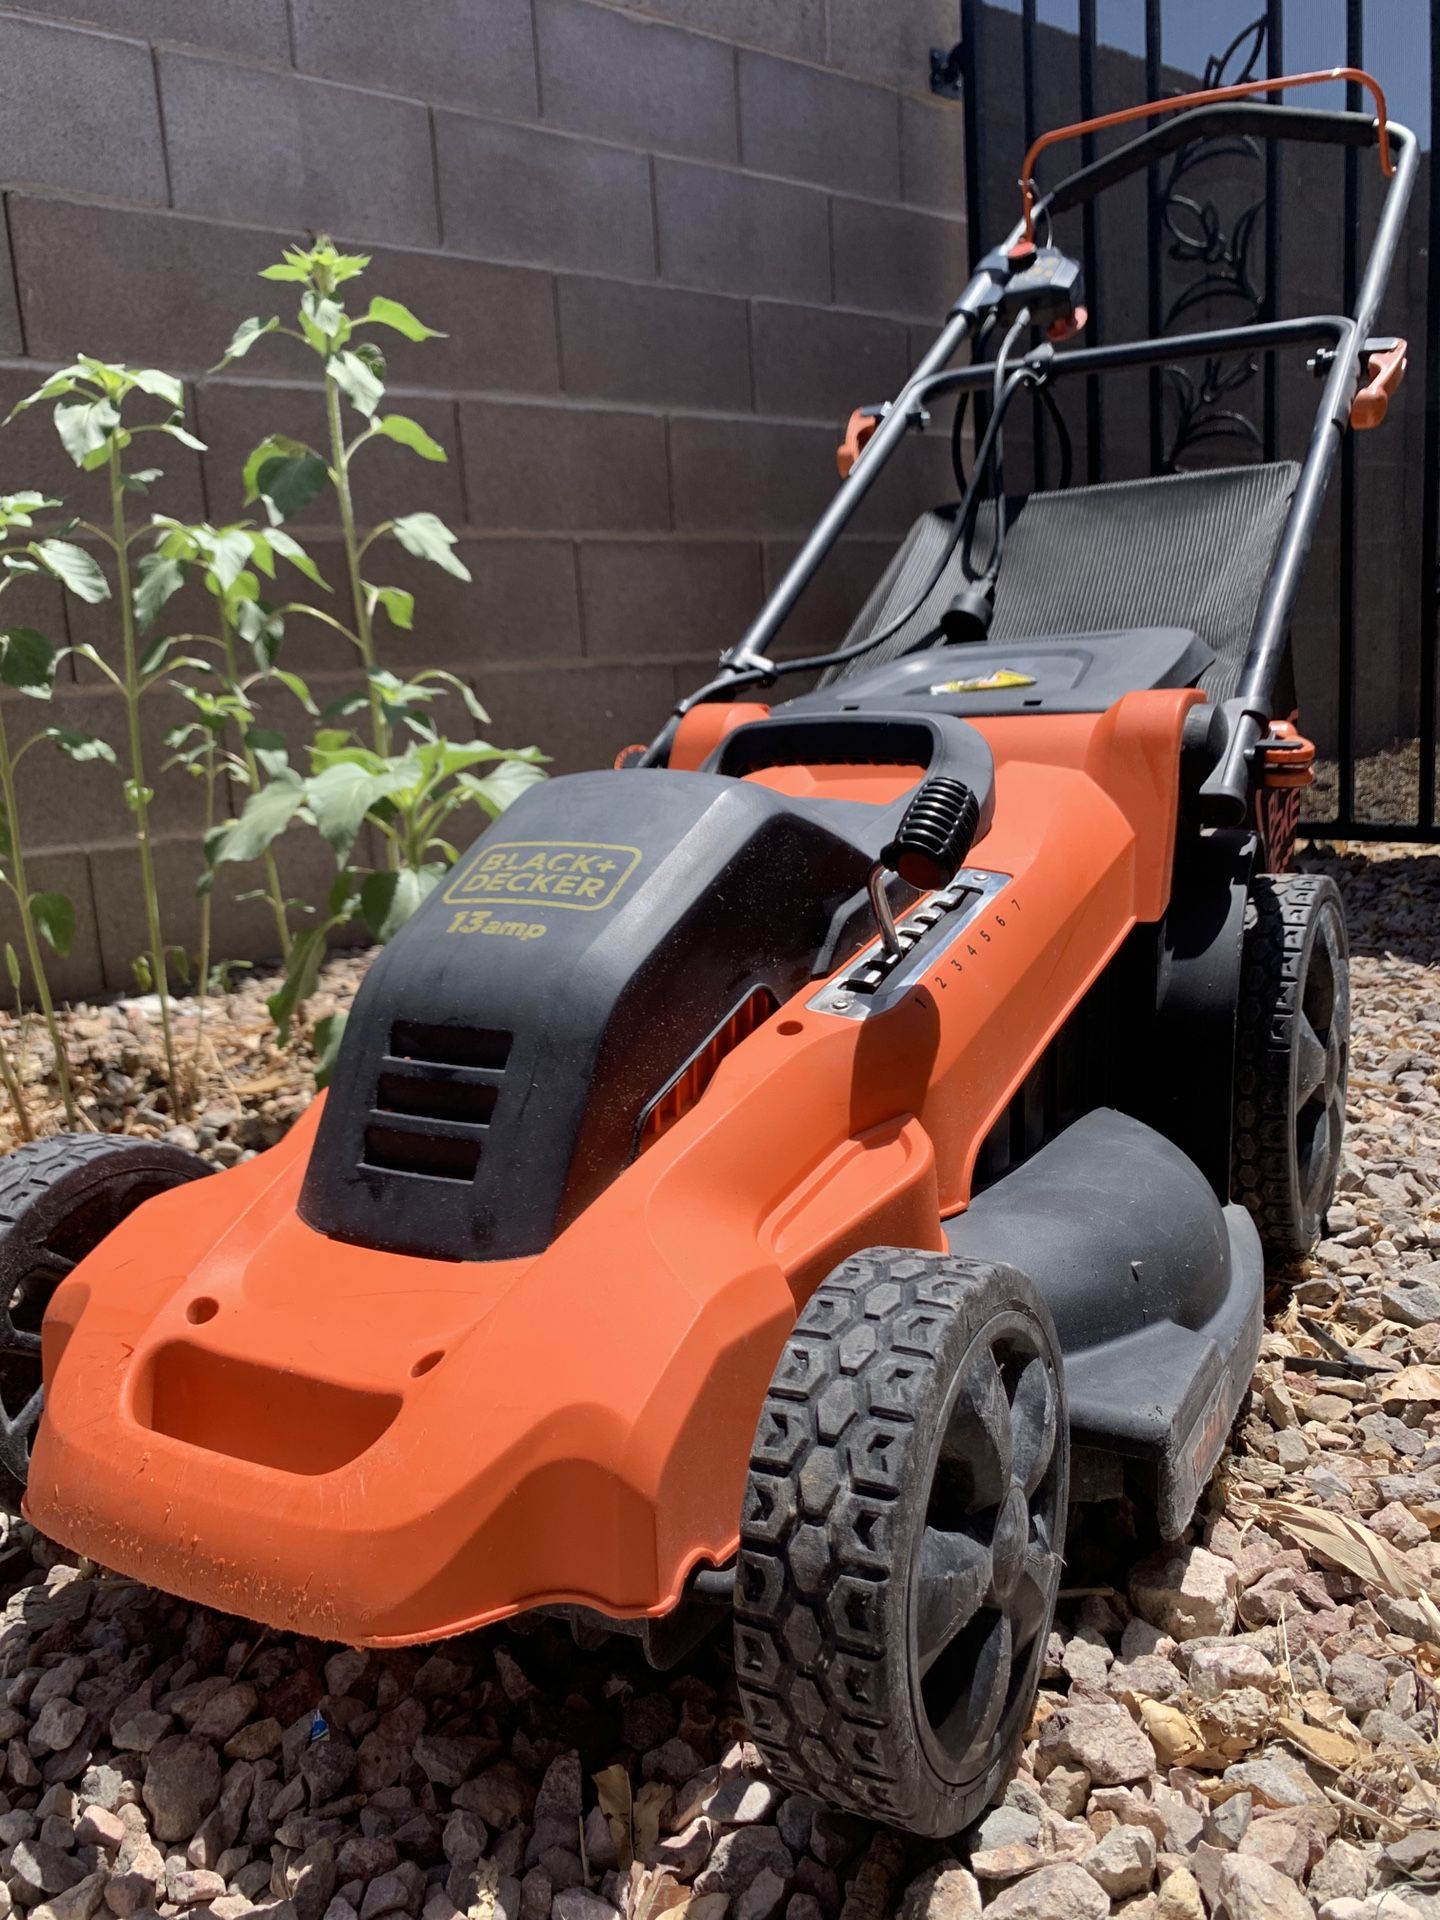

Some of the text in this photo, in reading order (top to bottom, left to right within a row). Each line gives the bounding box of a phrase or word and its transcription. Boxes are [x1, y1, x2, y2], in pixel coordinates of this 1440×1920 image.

[480, 852, 616, 874] BLACK+
[461, 872, 605, 898] DECKER
[914, 899, 1021, 1009] 1 2 3 4 5 6 7
